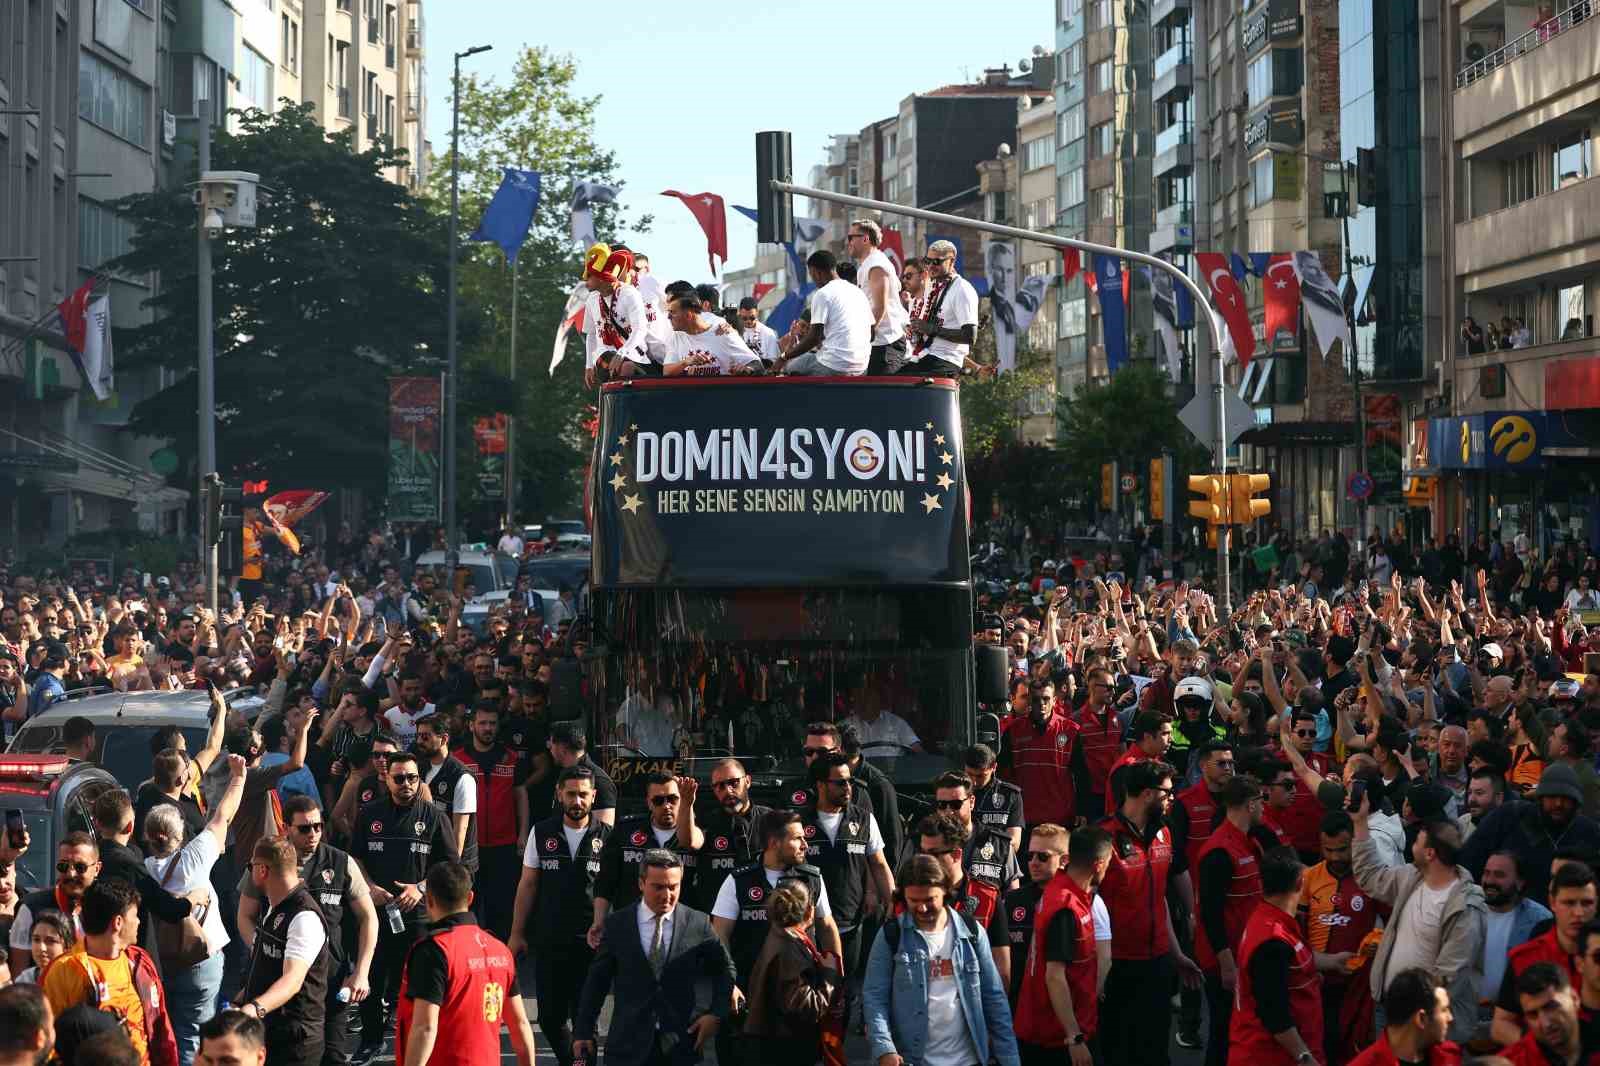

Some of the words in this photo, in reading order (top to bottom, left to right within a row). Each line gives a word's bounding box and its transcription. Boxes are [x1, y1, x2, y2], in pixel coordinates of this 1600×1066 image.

[658, 490, 690, 514] HER
[695, 489, 738, 513] SENE
[634, 760, 684, 775] KALE
